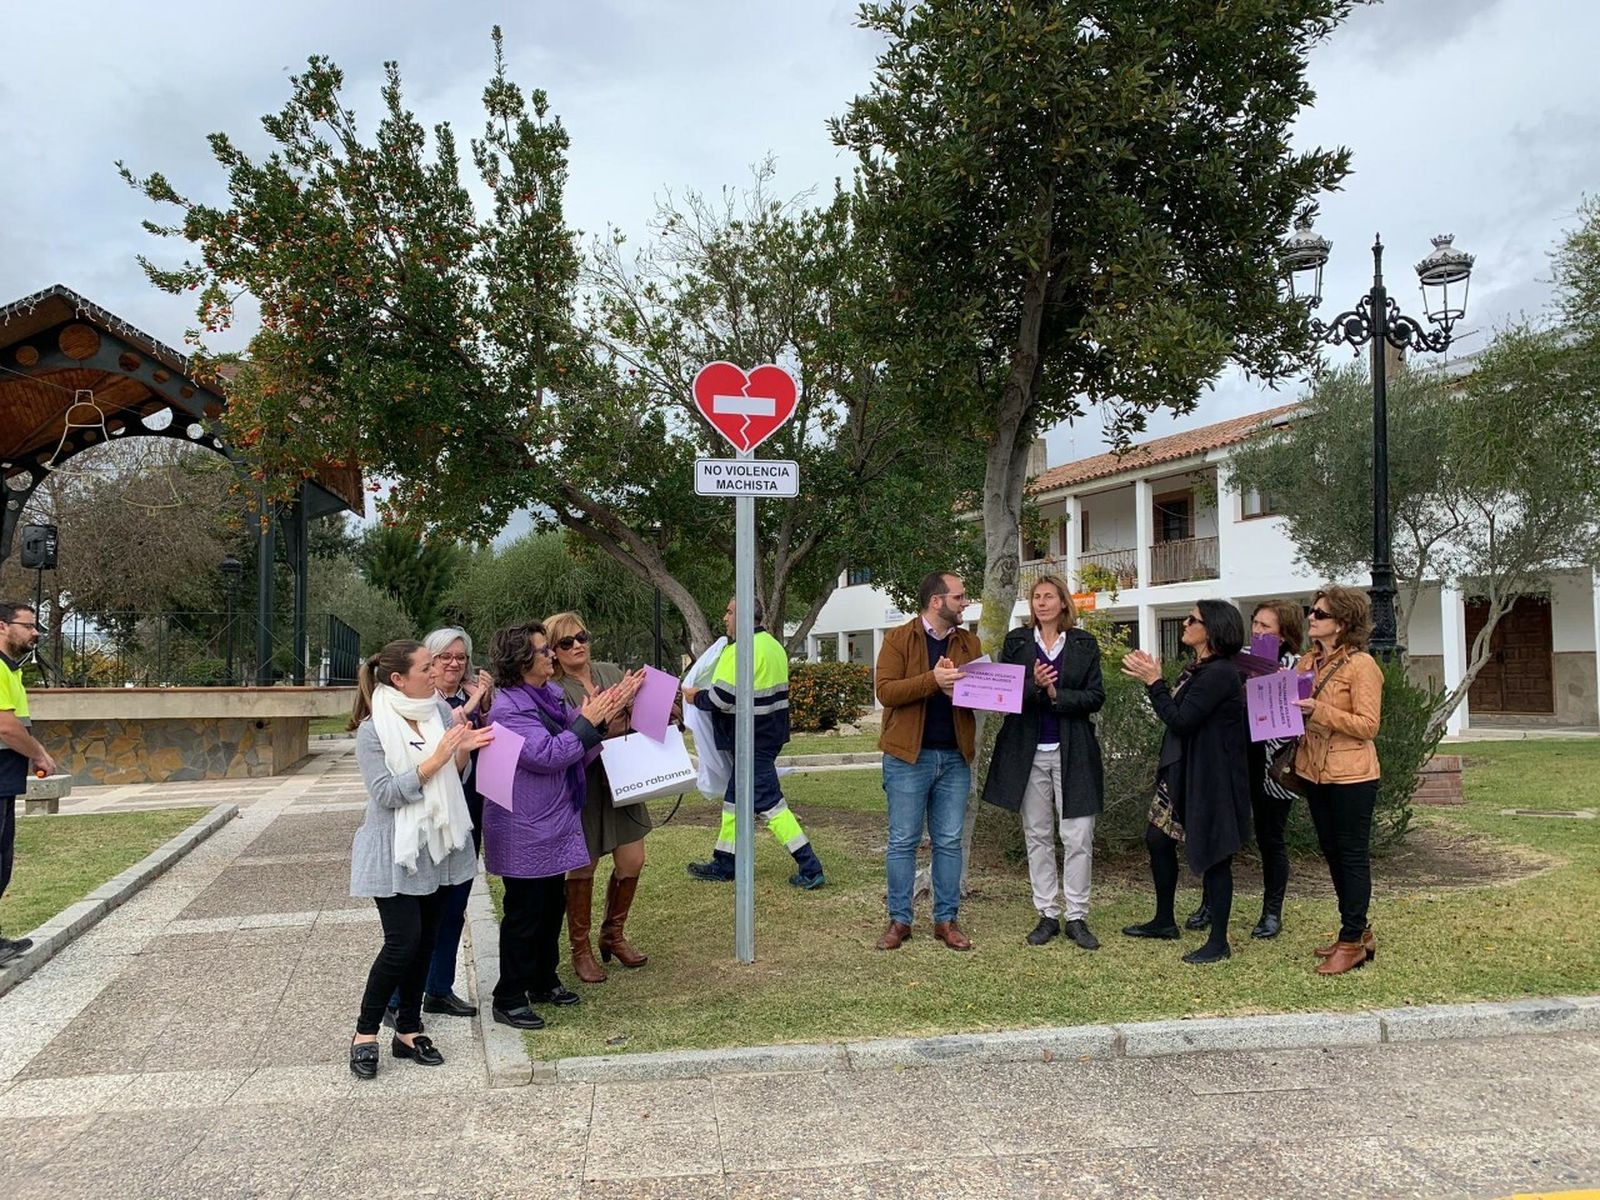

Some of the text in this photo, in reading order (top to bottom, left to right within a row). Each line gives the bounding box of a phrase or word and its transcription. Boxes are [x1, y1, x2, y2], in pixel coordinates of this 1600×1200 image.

[704, 465, 790, 477] NO VIOLENCIA
[716, 479, 778, 491] MACHISTA
[614, 768, 692, 797] paco rabanne
